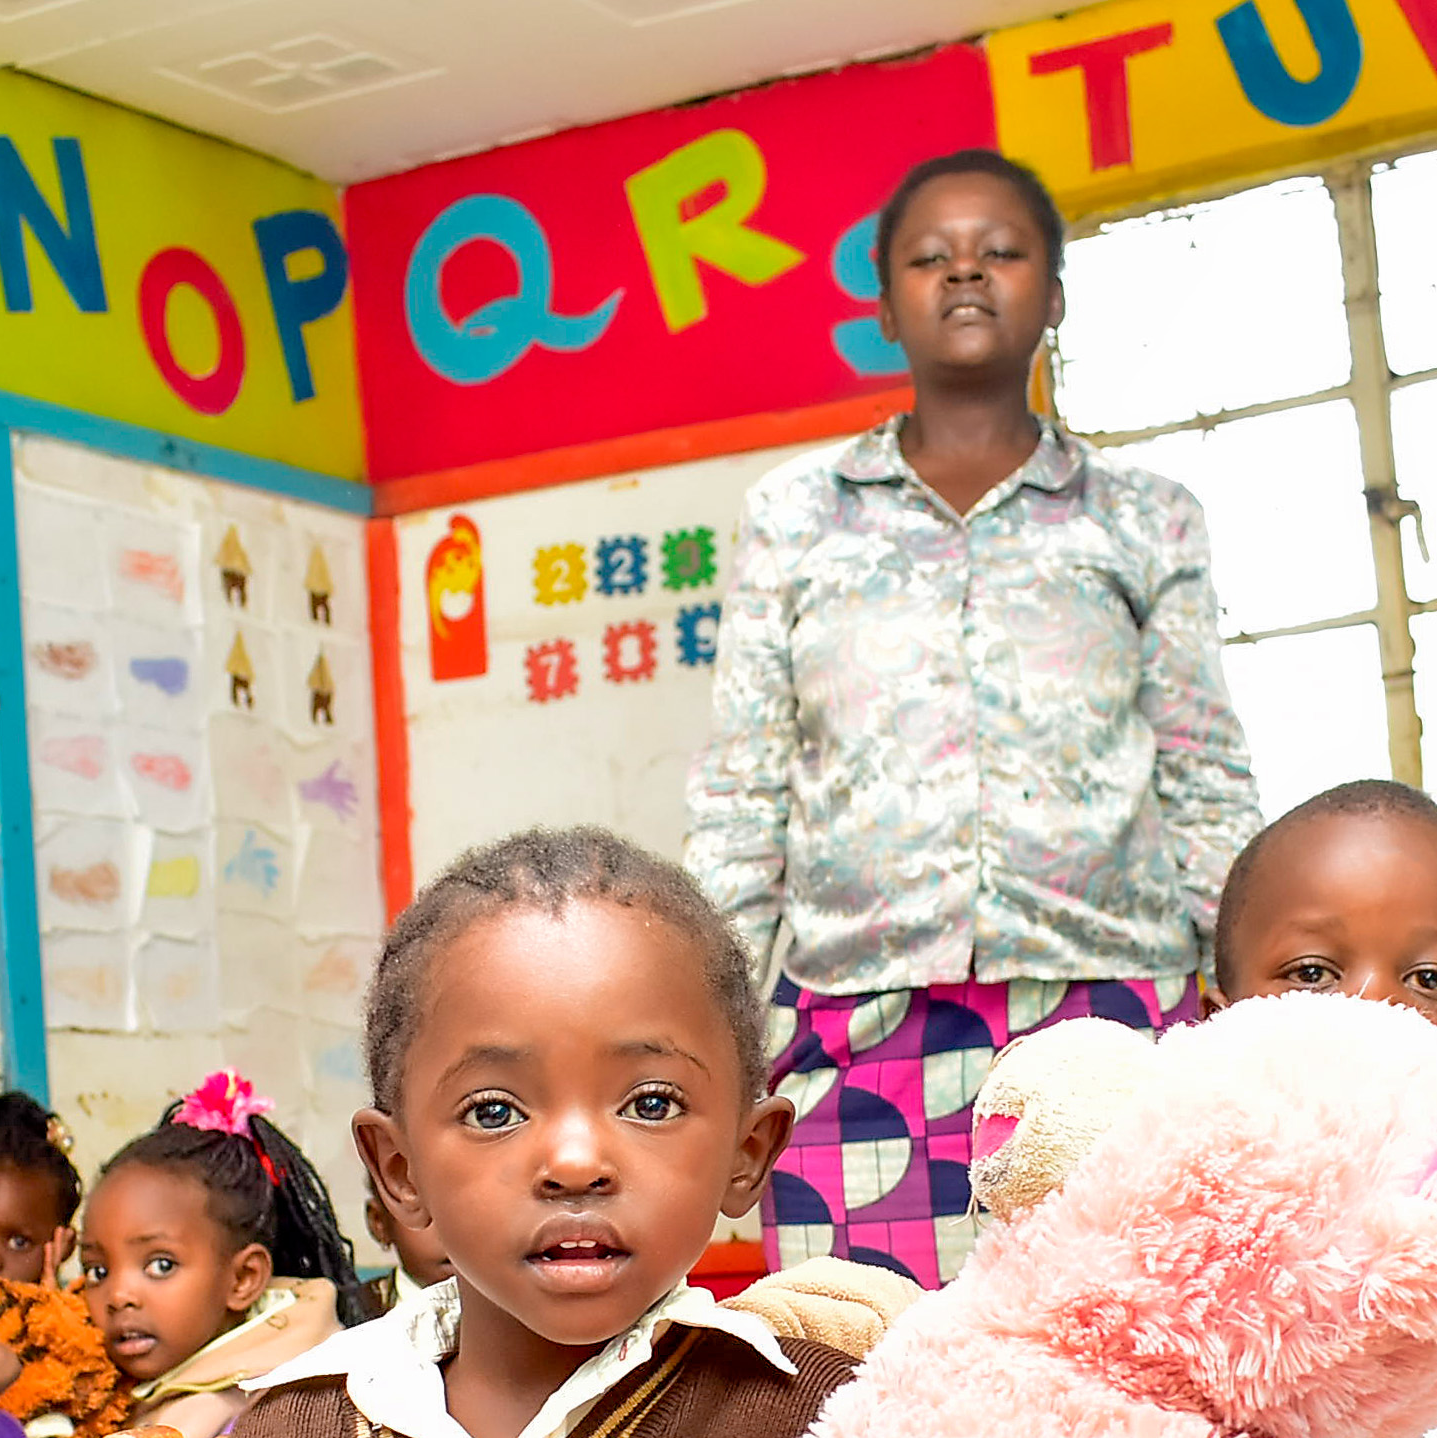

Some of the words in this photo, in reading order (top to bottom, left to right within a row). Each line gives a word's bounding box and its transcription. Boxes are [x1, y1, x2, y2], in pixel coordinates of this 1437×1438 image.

[137, 245, 245, 416] O
[251, 209, 349, 403] P
[404, 192, 624, 386] Q
[625, 128, 807, 334] R
[1030, 21, 1173, 172] T
[1216, 0, 1363, 126] U
[551, 559, 572, 592] 2
[610, 548, 634, 584] 2
[538, 655, 561, 689] 7
